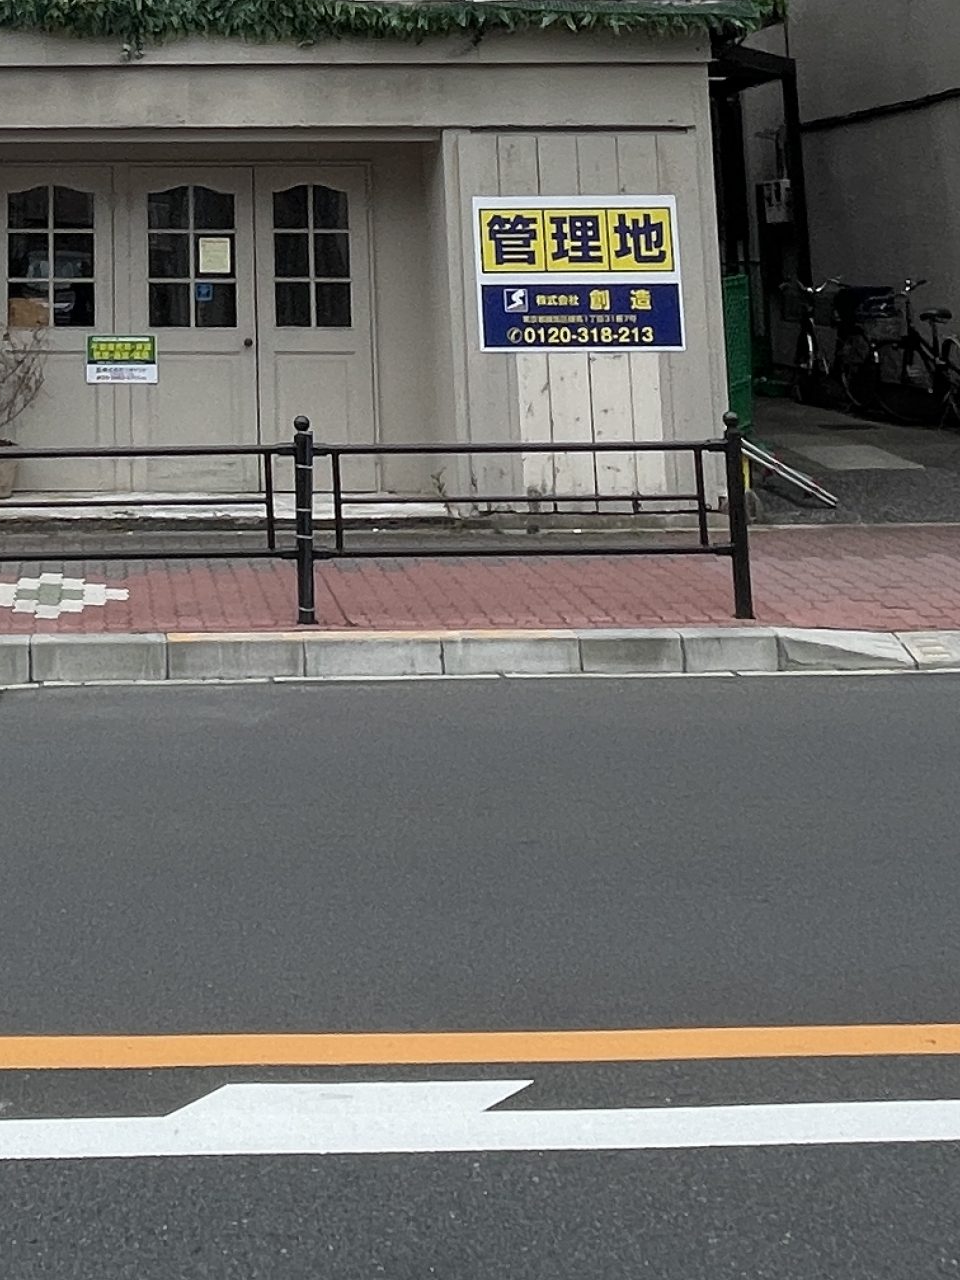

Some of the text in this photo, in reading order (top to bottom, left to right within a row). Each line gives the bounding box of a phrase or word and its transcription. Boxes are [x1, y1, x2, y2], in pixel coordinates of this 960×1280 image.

[487, 213, 666, 266] 管理地
[524, 326, 654, 343] 0120-318-213
